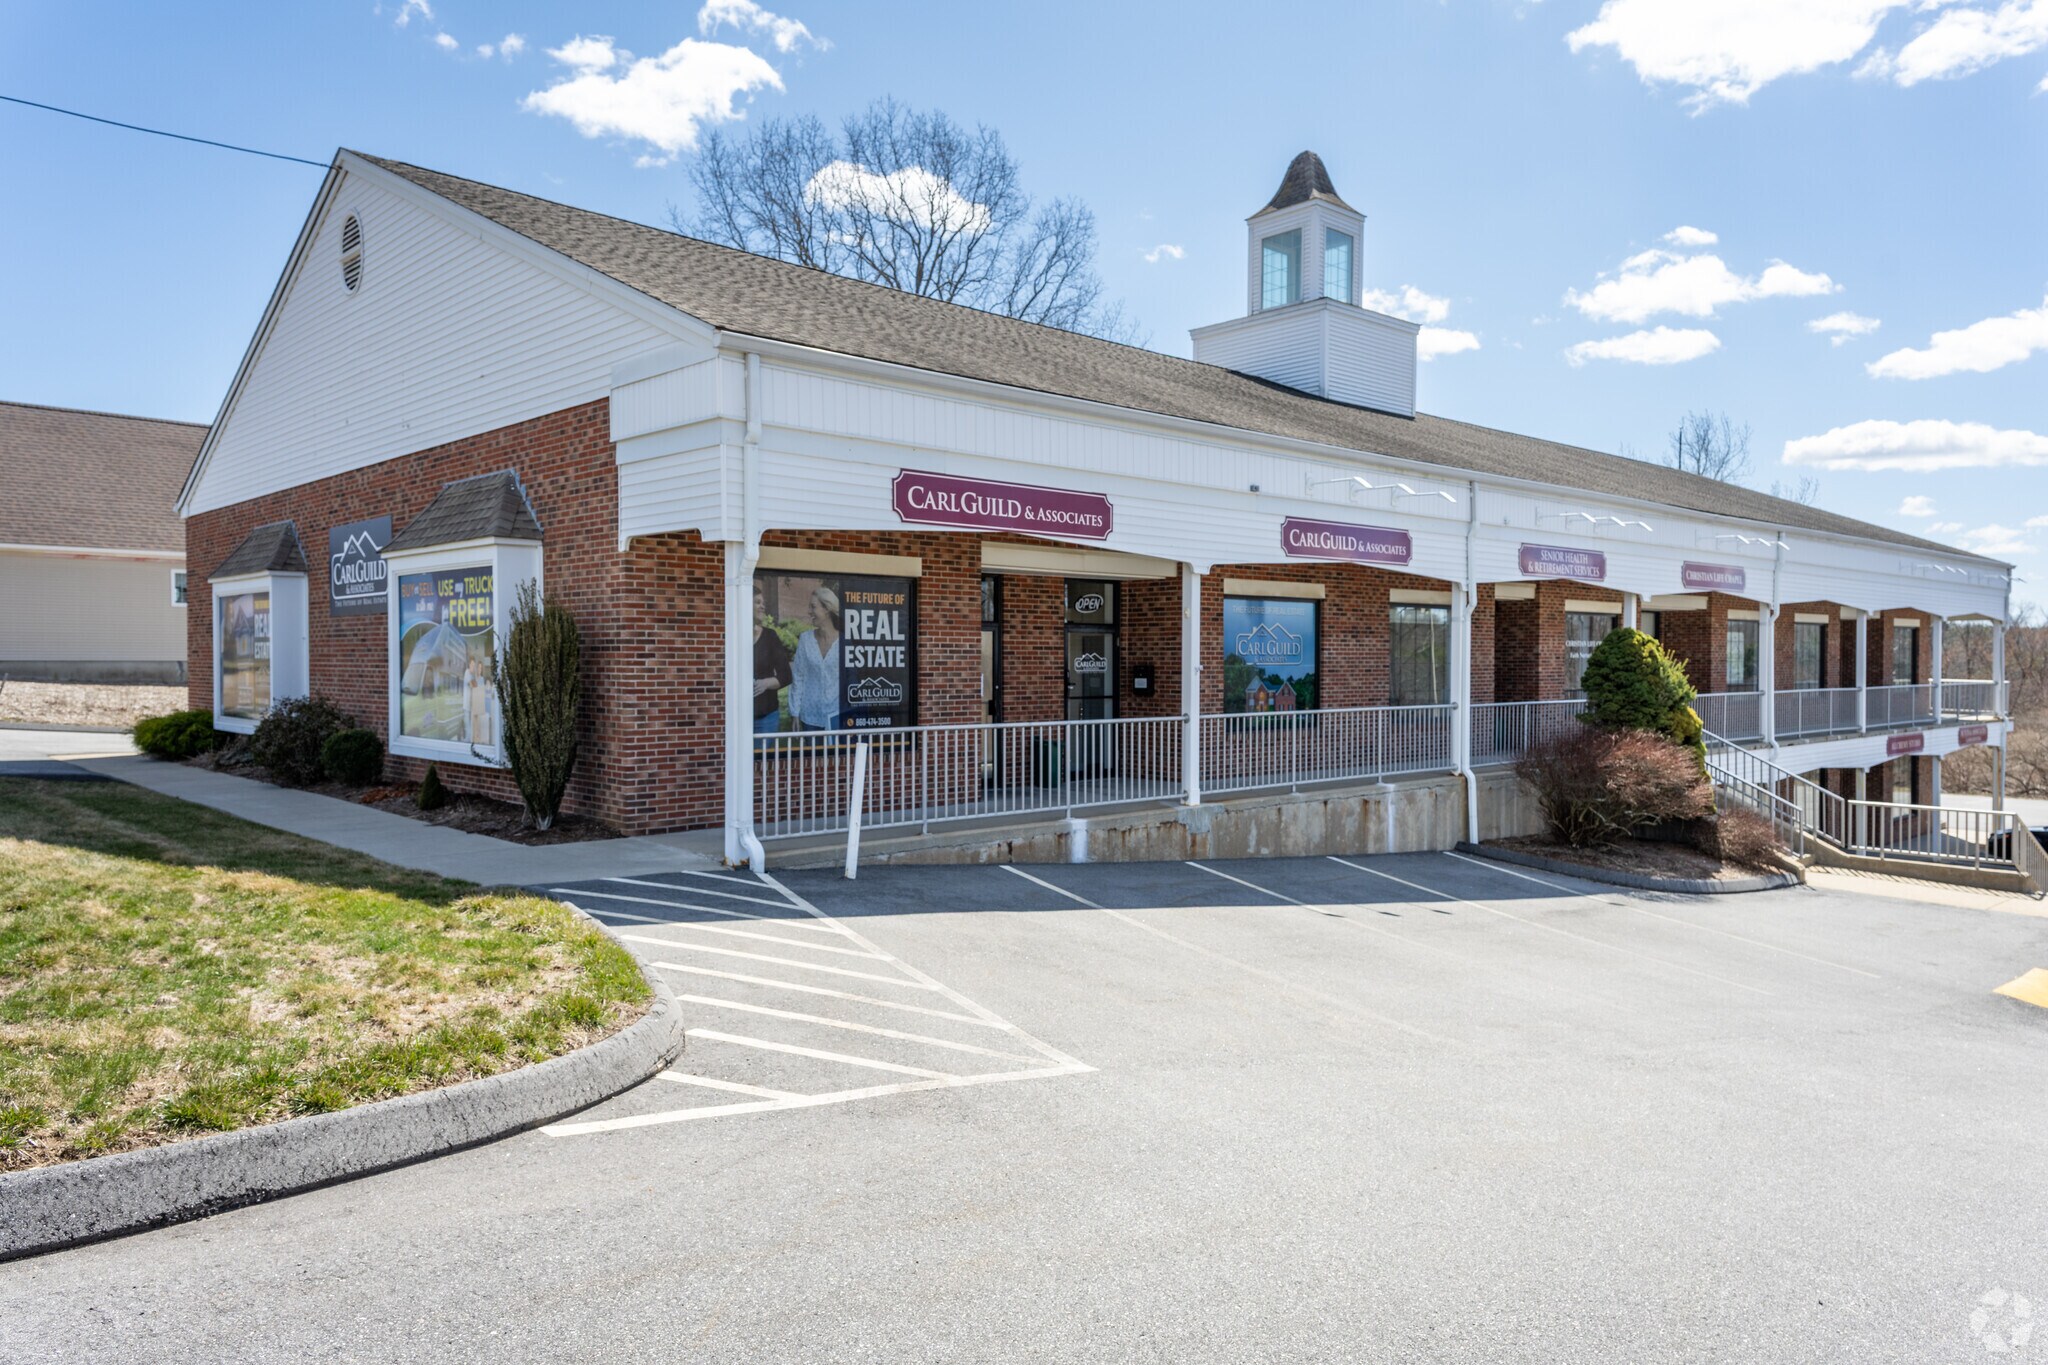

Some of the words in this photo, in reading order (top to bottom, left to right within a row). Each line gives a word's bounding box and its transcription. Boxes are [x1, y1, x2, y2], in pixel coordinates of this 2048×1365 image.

[907, 486, 1022, 519] CARLGUILD
[1024, 506, 1035, 520] &
[1037, 509, 1103, 527] ASSOCIATES
[1289, 529, 1357, 551] CARLGUILD
[1358, 541, 1365, 552] &
[1365, 542, 1407, 556] ASSOCIATES
[1541, 549, 1565, 563] SENIOR
[1565, 551, 1588, 565] HEALTH
[334, 560, 387, 586] CARLGUILD
[1527, 562, 1534, 573] &
[1534, 562, 1573, 576] RETIREMENT
[1574, 565, 1600, 577] SERVICES
[1686, 570, 1713, 582] CHRISTIAN
[1713, 572, 1724, 583] LIFE
[418, 582, 434, 596] SELL
[438, 579, 454, 597] USE
[464, 575, 494, 595] TRUCK
[845, 591, 861, 603] THE
[862, 592, 894, 605] FUTURE
[894, 593, 905, 605] OF
[1078, 598, 1101, 610] OPEN
[449, 597, 490, 628] FREE!
[845, 609, 905, 641] REAL
[1238, 640, 1301, 656] CARLGUILD
[845, 645, 905, 668] ESTATE
[849, 687, 900, 698] CARLGUILD
